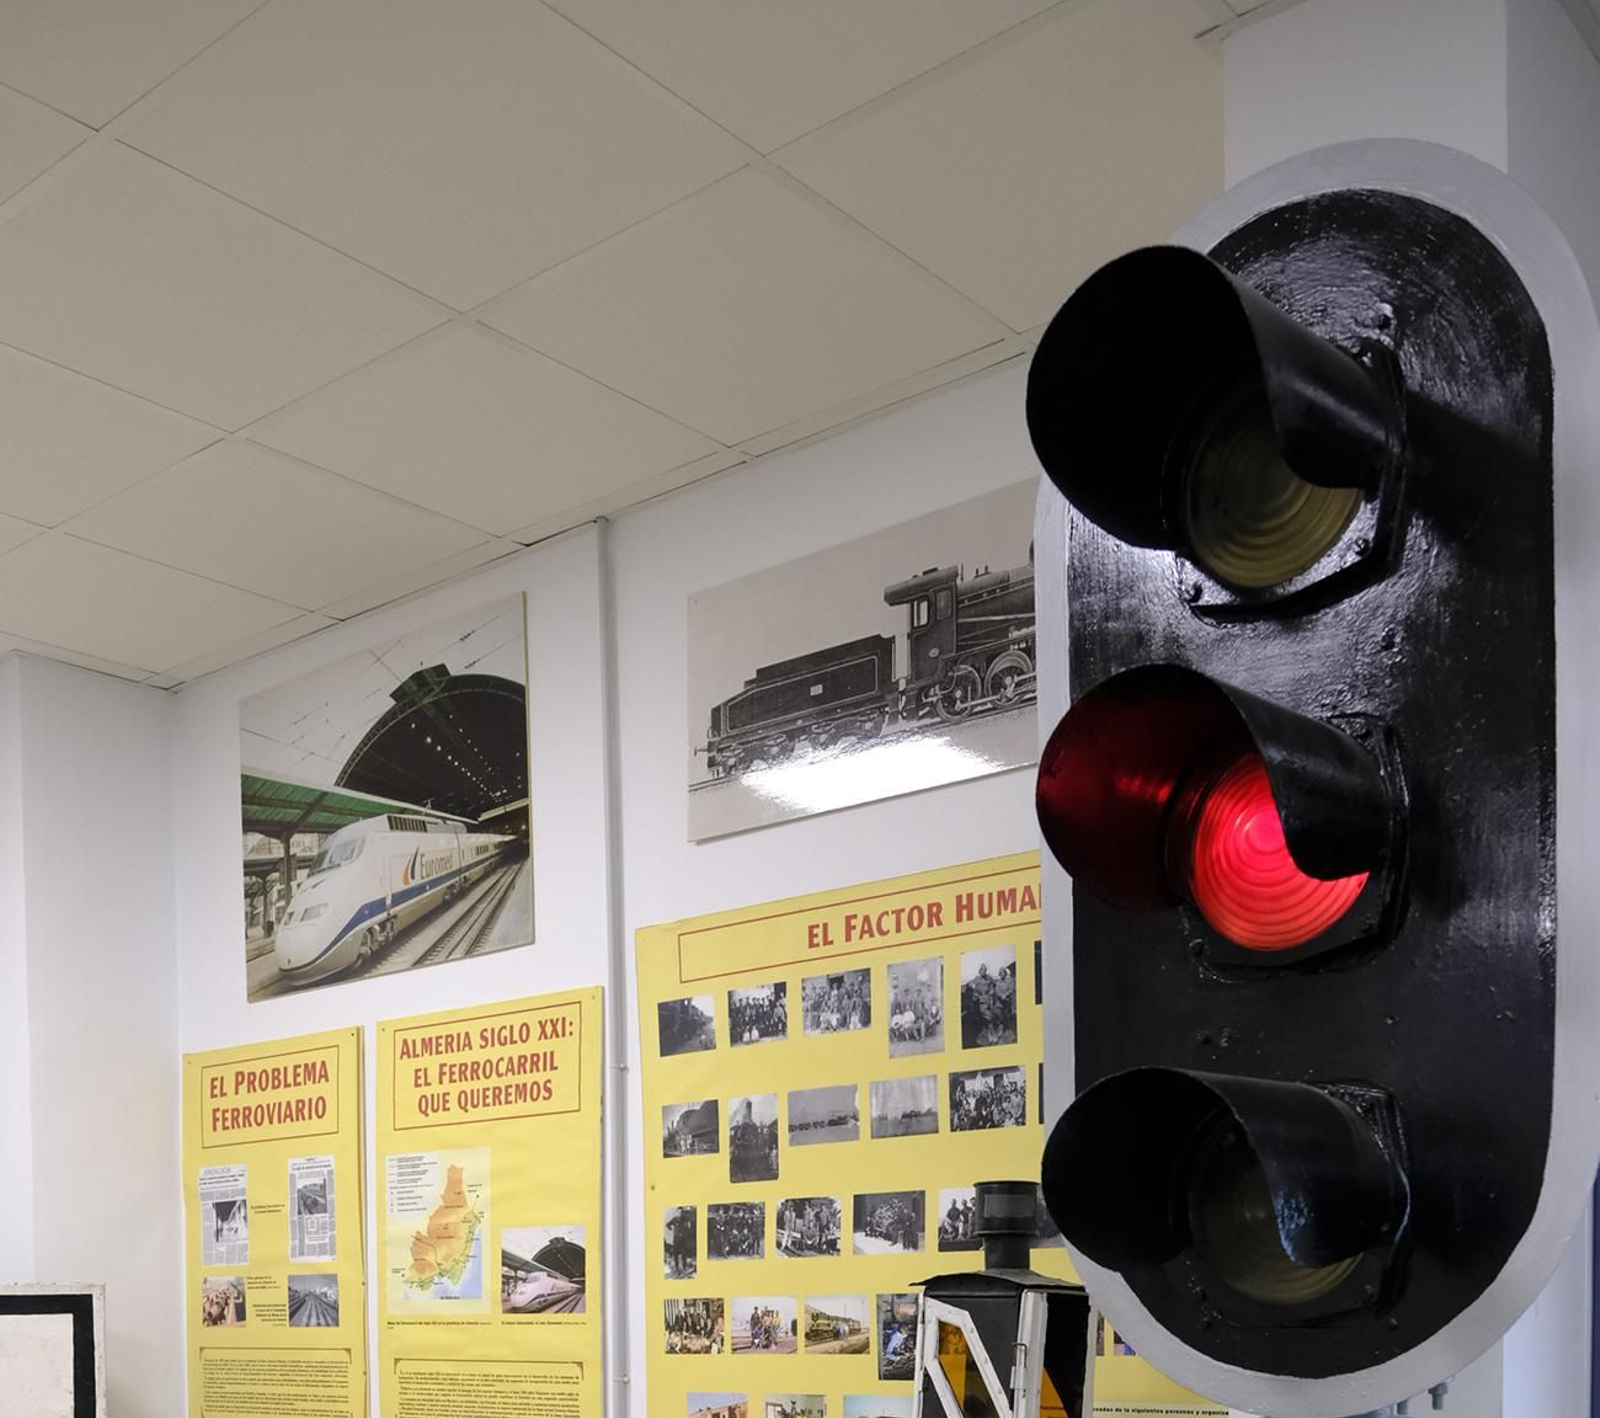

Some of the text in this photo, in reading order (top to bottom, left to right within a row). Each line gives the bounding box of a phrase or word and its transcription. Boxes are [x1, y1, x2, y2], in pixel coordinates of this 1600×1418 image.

[420, 850, 454, 880] Euromed
[808, 885, 1041, 949] EL FACTOR HUMA
[400, 1017, 573, 1060] ALMERIA SIGLO XXI:
[210, 1060, 329, 1099] EL PROBLEMA
[414, 1050, 558, 1088] EL FERROCARRIL
[212, 1096, 327, 1132] FERROVIARIO
[418, 1079, 553, 1117] QUE QUEREMOS
